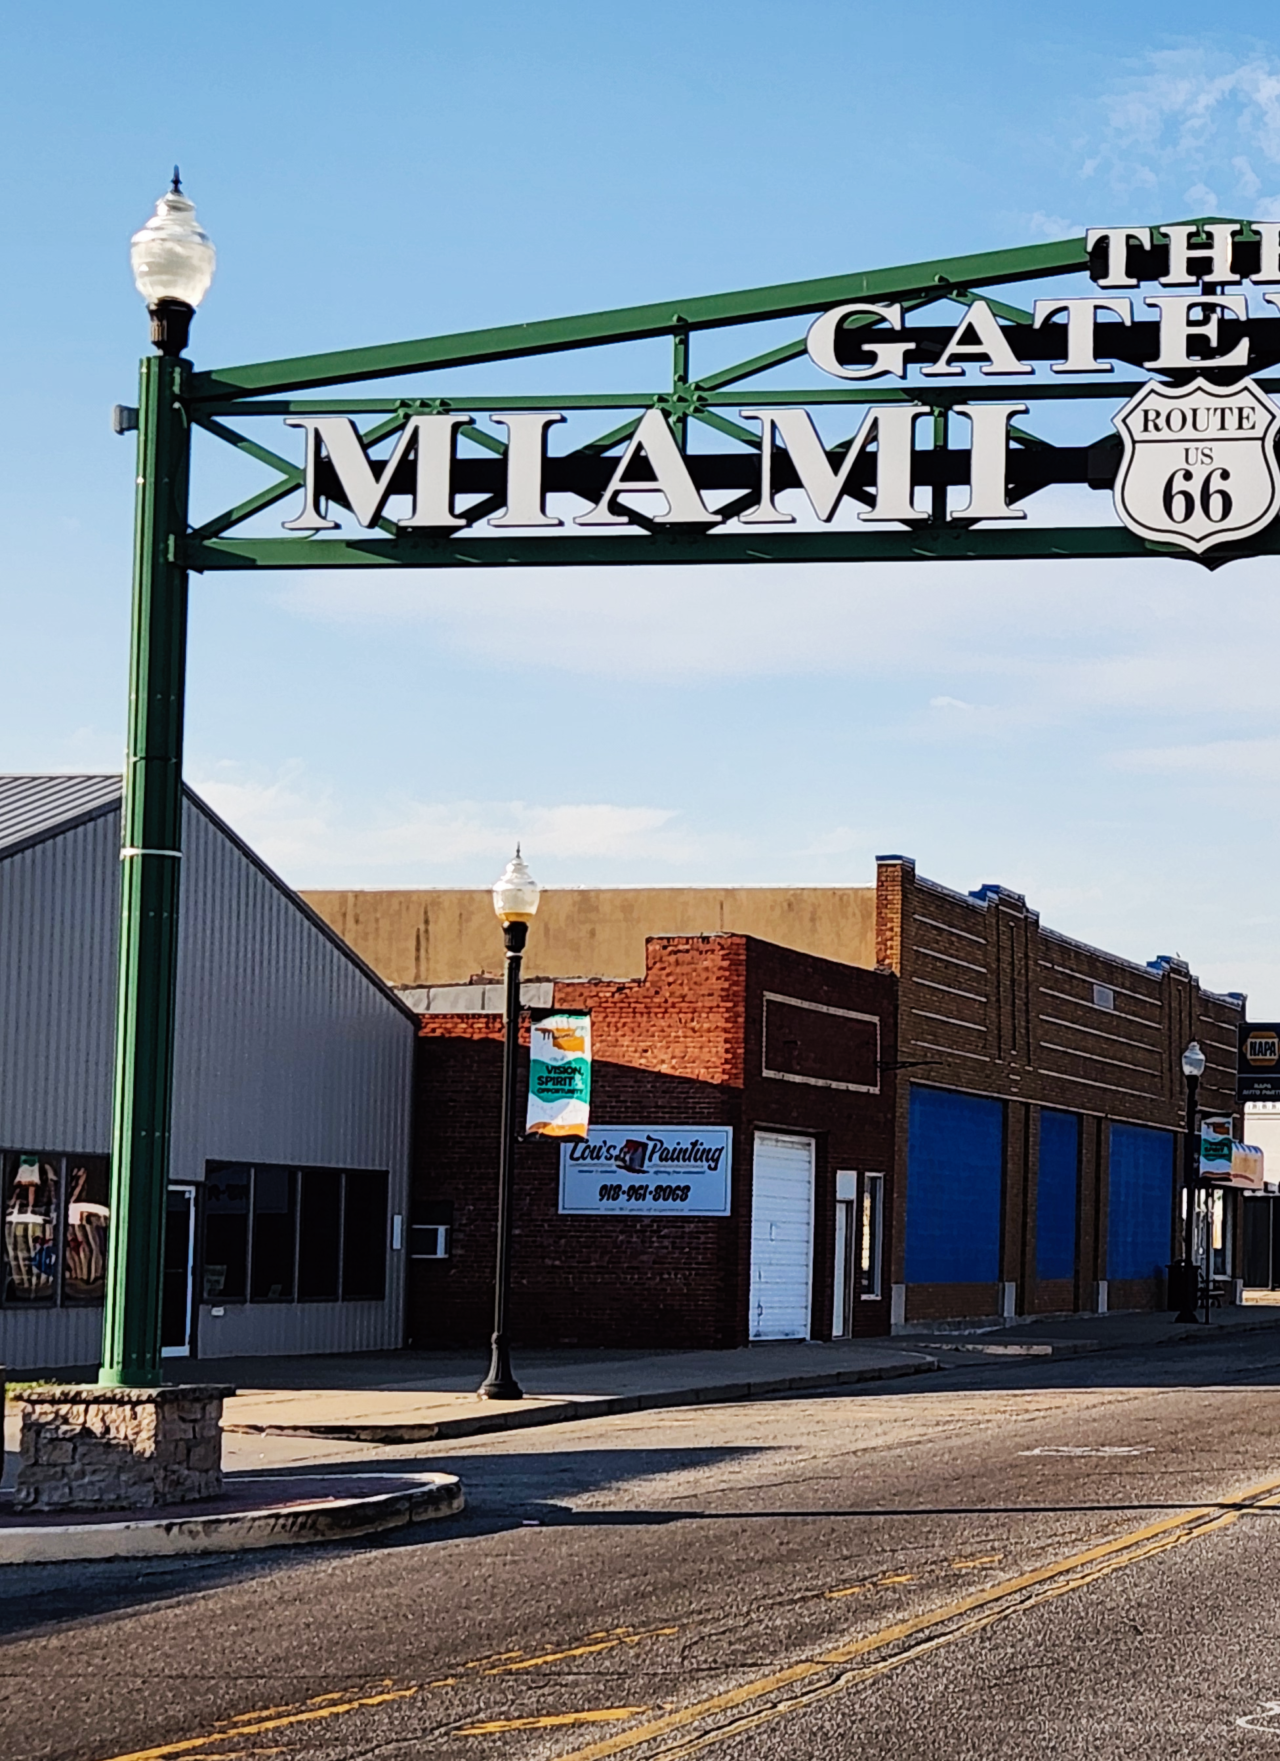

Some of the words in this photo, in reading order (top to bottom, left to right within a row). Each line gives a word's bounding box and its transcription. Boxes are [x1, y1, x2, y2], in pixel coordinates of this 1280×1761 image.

[1140, 406, 1257, 433] ROUTE
[282, 403, 1029, 531] MIAMI
[1183, 447, 1214, 466] US
[1162, 467, 1233, 524] 66
[1249, 1041, 1277, 1057] NAPA
[537, 1076, 574, 1087] SPIRIT
[569, 1140, 616, 1162] Lou's
[646, 1134, 726, 1172] Painting
